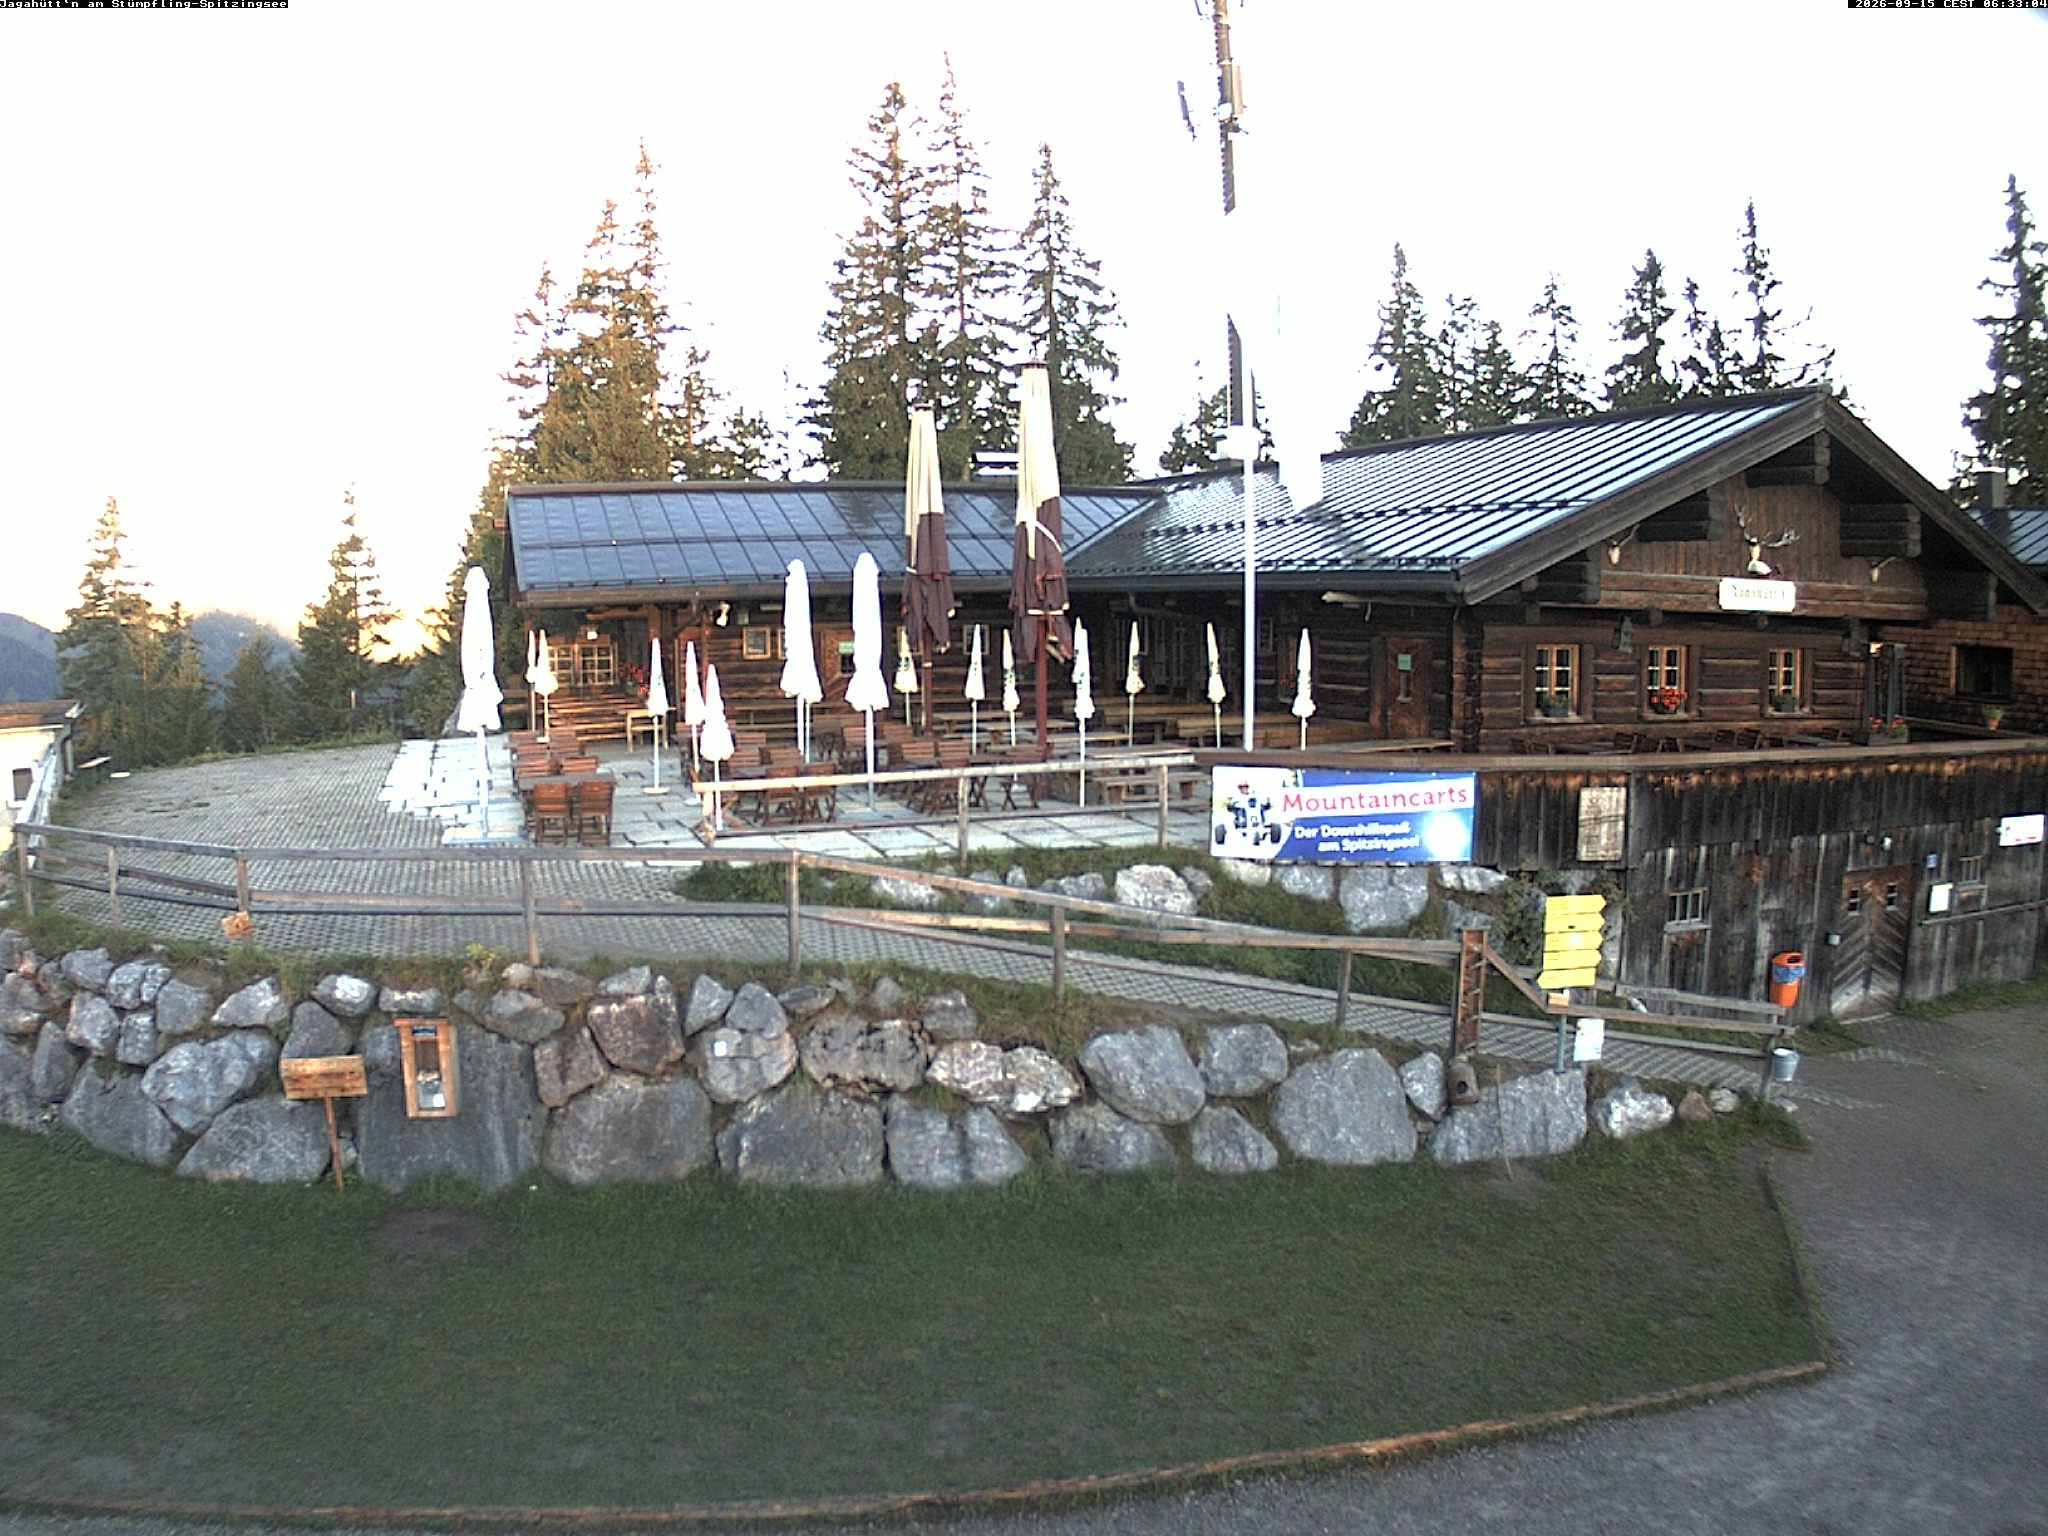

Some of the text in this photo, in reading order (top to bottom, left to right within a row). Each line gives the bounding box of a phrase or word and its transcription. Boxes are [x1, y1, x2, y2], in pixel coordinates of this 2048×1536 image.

[1282, 787, 1468, 812] Mountaincarts
[1295, 826, 1318, 838] Der
[1318, 841, 1341, 852] am
